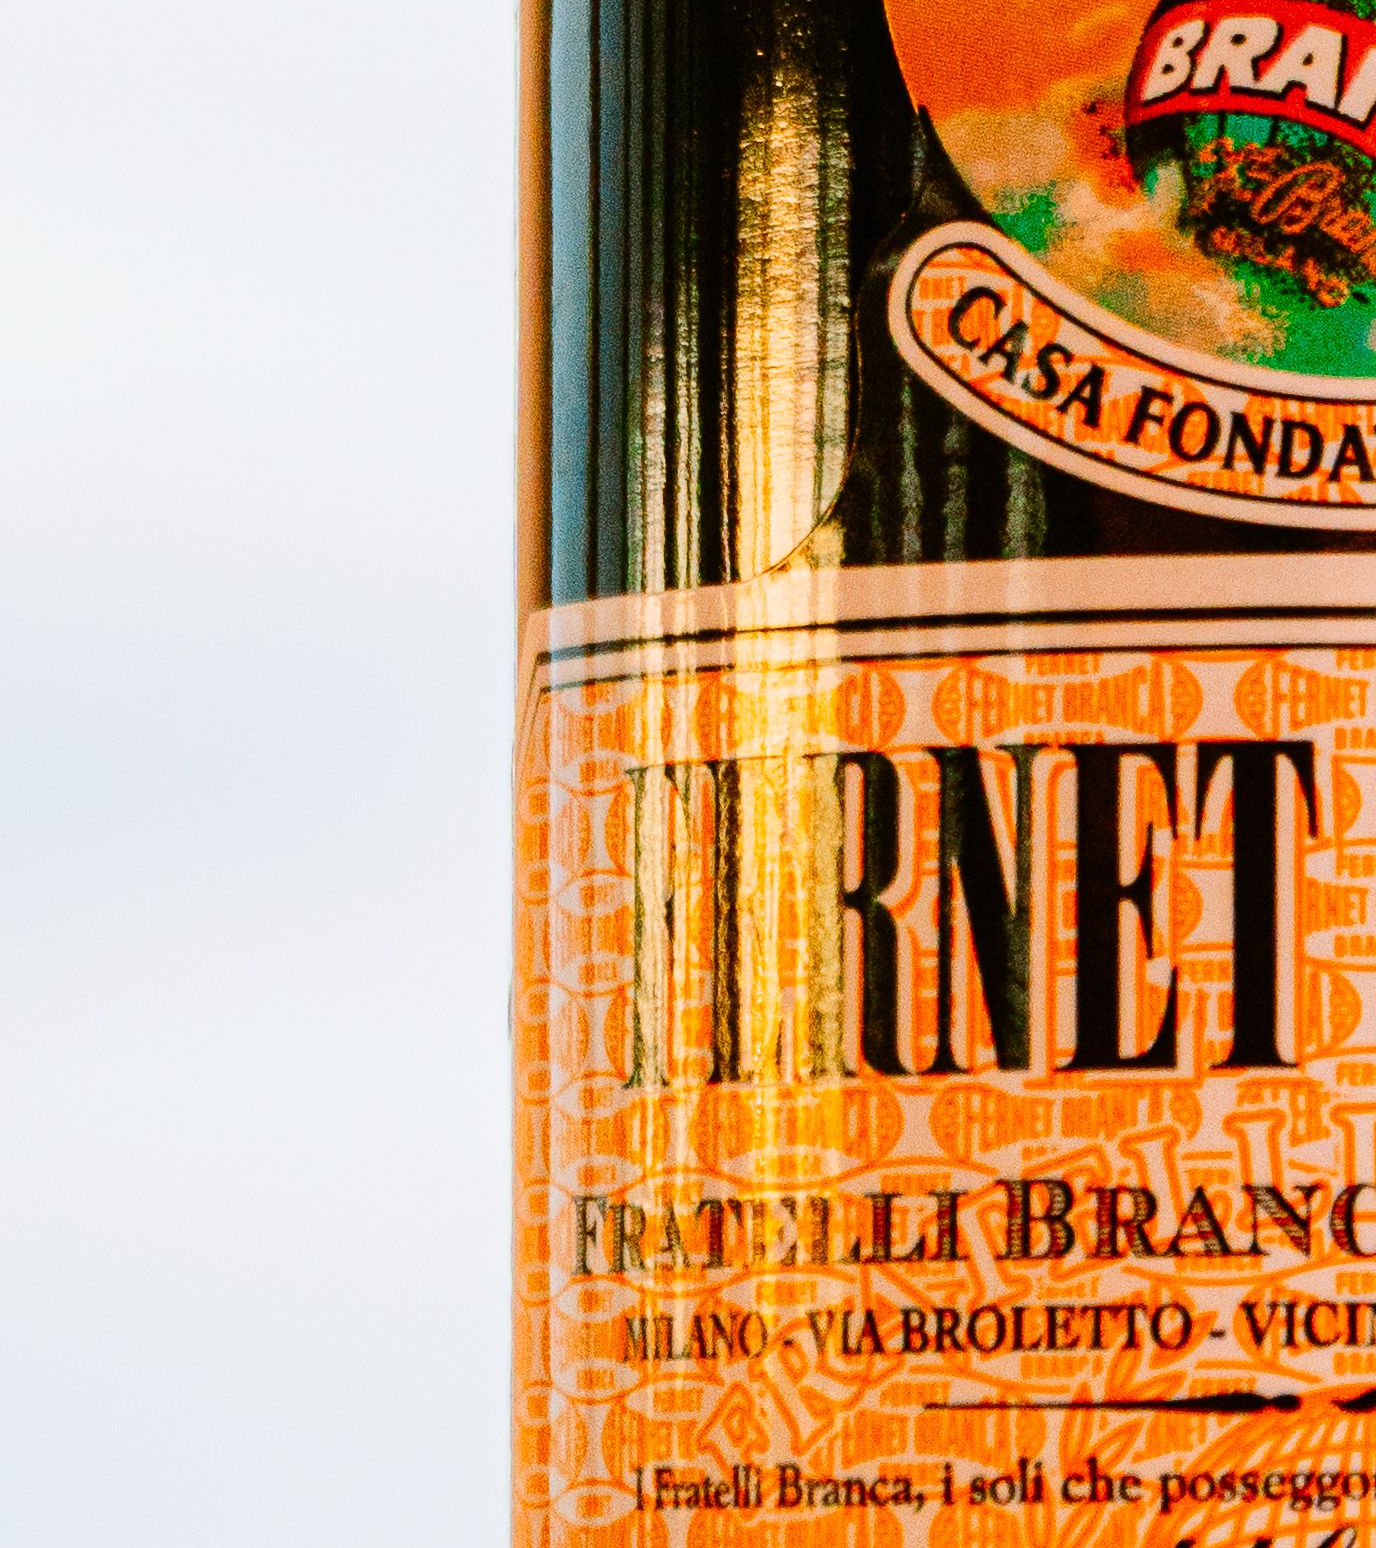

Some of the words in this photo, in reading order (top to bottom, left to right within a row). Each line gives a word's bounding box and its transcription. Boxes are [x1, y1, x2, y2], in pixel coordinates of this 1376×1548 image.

[947, 284, 1106, 432] CASA
[571, 1189, 969, 1276] FRATELLI
[622, 1308, 768, 1363] MILANO
[806, 1306, 887, 1357] VIA
[898, 1303, 1194, 1353] BROLETTO
[653, 1462, 763, 1512] Fratelli
[776, 1461, 926, 1513] Branca,
[940, 1460, 954, 1506] i
[969, 1456, 1044, 1506] soli
[1060, 1456, 1143, 1505] che
